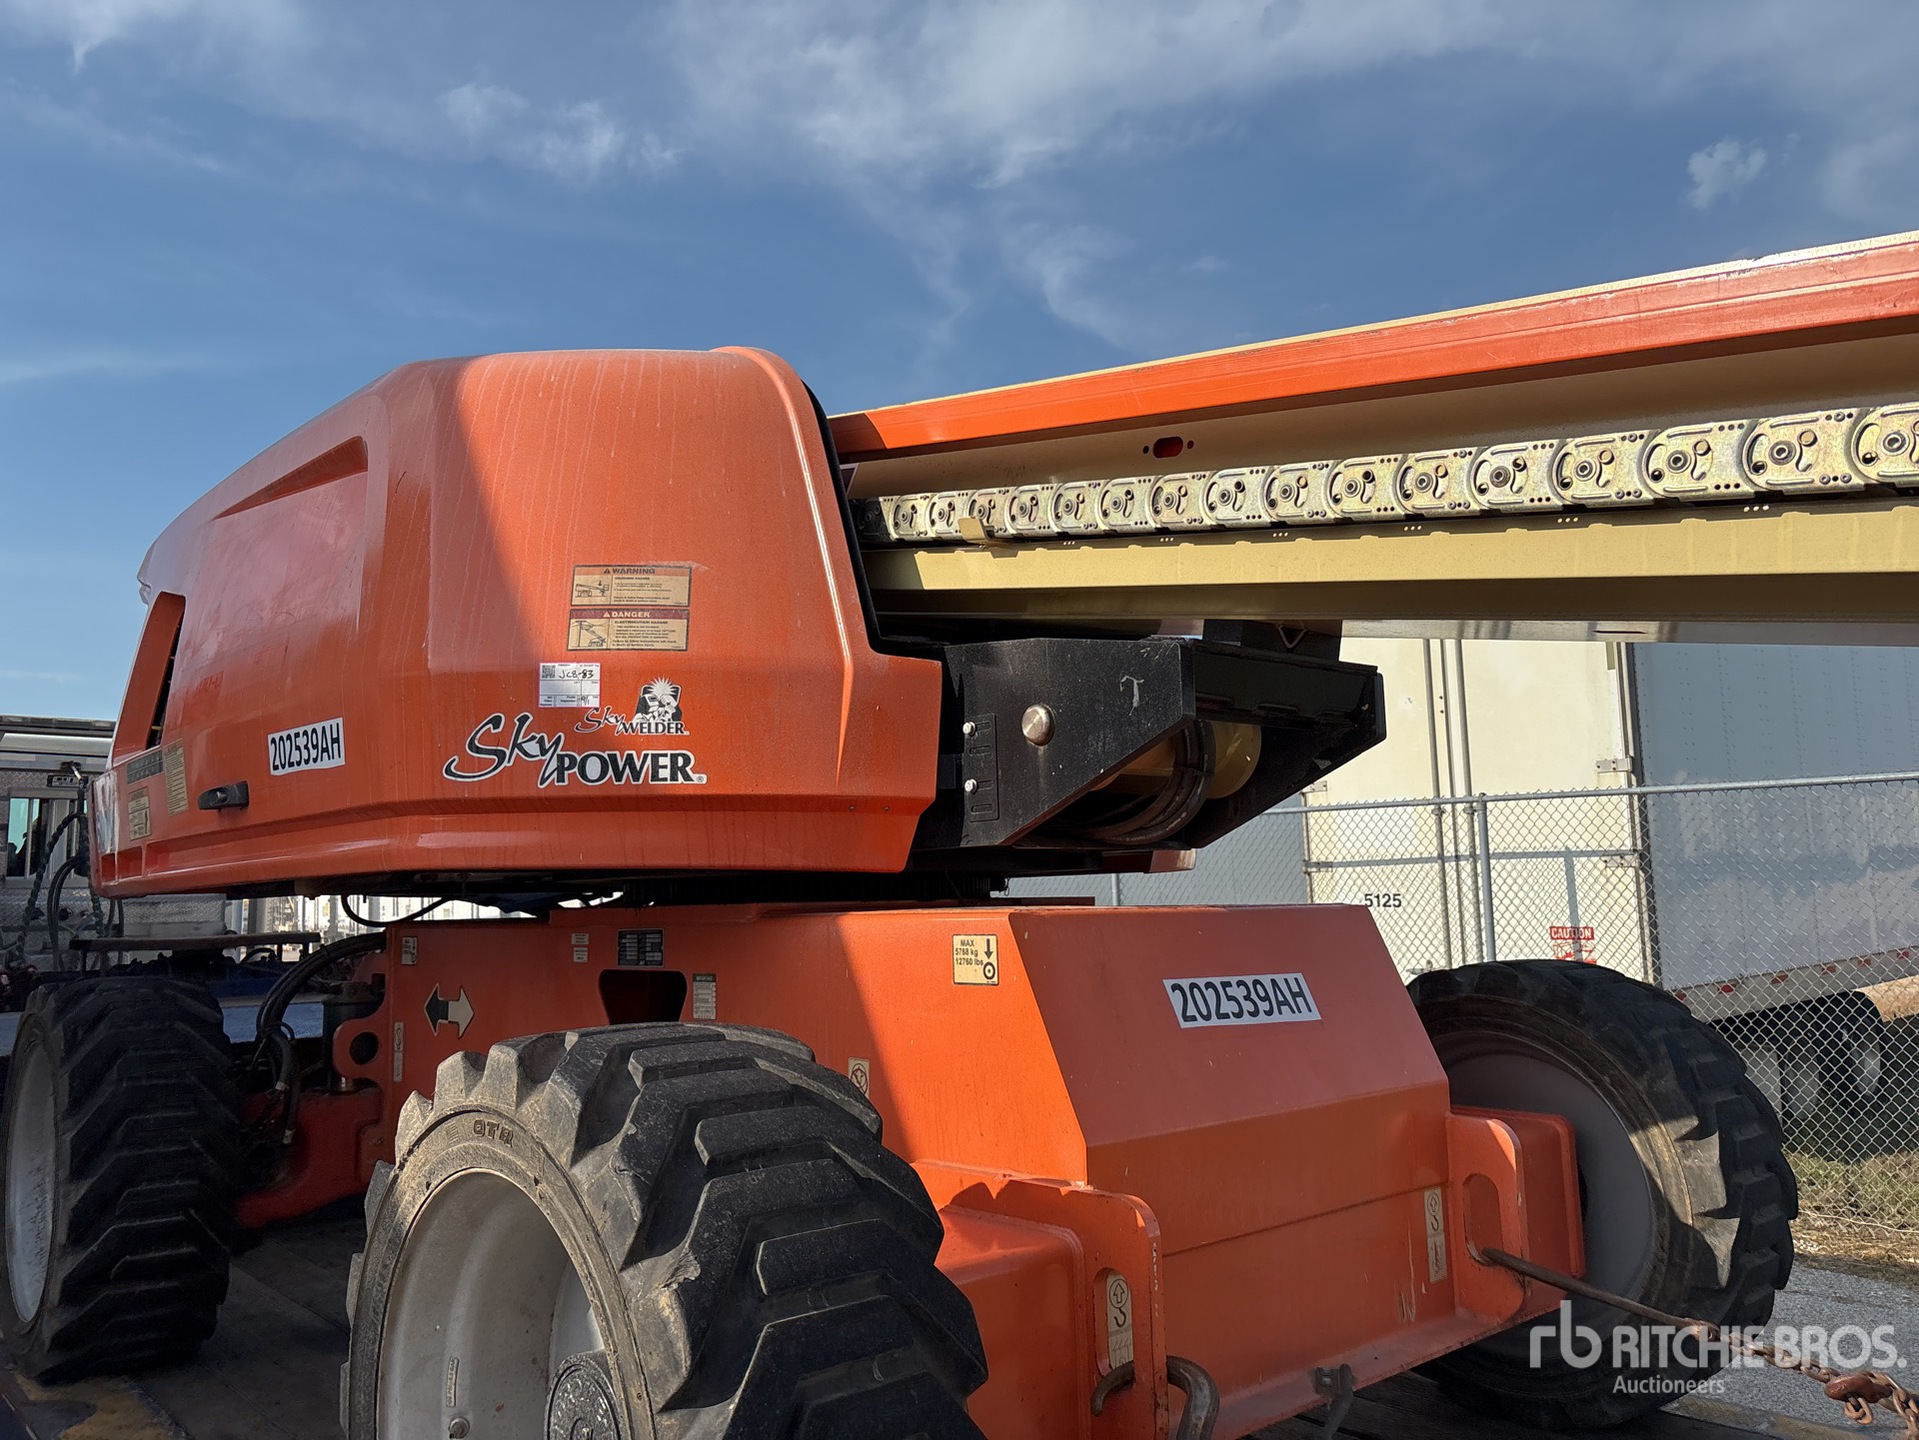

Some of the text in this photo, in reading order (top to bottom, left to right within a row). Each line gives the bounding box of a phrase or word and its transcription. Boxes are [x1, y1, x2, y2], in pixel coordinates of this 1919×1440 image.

[622, 721, 685, 735] WELDER
[270, 721, 342, 772] 202539AH
[444, 711, 695, 788] Sky POWER
[1364, 893, 1402, 908] 5125
[960, 939, 975, 947] MAX
[970, 948, 979, 957] kg
[1170, 977, 1313, 1023] 202539AH
[473, 1119, 514, 1149] OTR
